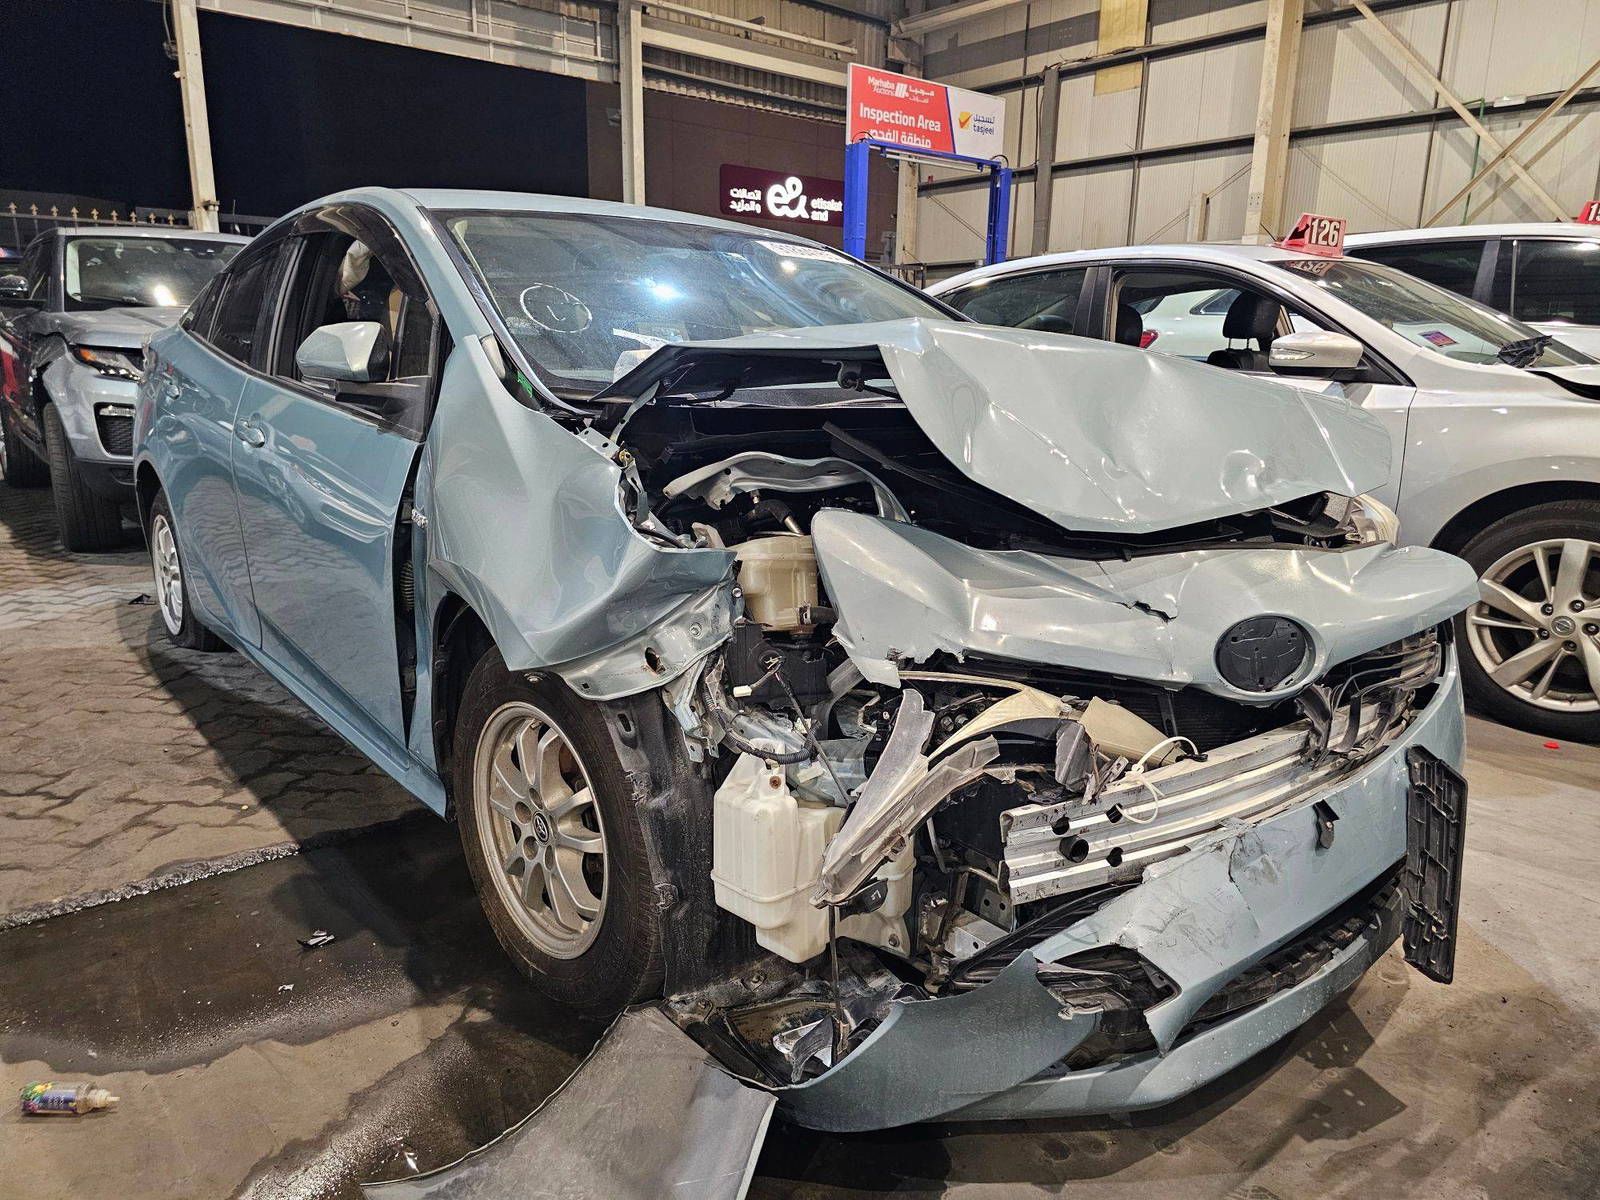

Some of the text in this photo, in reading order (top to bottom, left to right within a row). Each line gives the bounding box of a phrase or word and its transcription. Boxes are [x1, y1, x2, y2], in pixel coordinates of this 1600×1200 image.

[868, 76, 895, 90] Marhaba
[859, 102, 941, 132] Inspection Area
[973, 124, 995, 136] tasjeel
[901, 131, 931, 149] منطقة
[810, 209, 829, 222] and
[1311, 218, 1340, 246] 126
